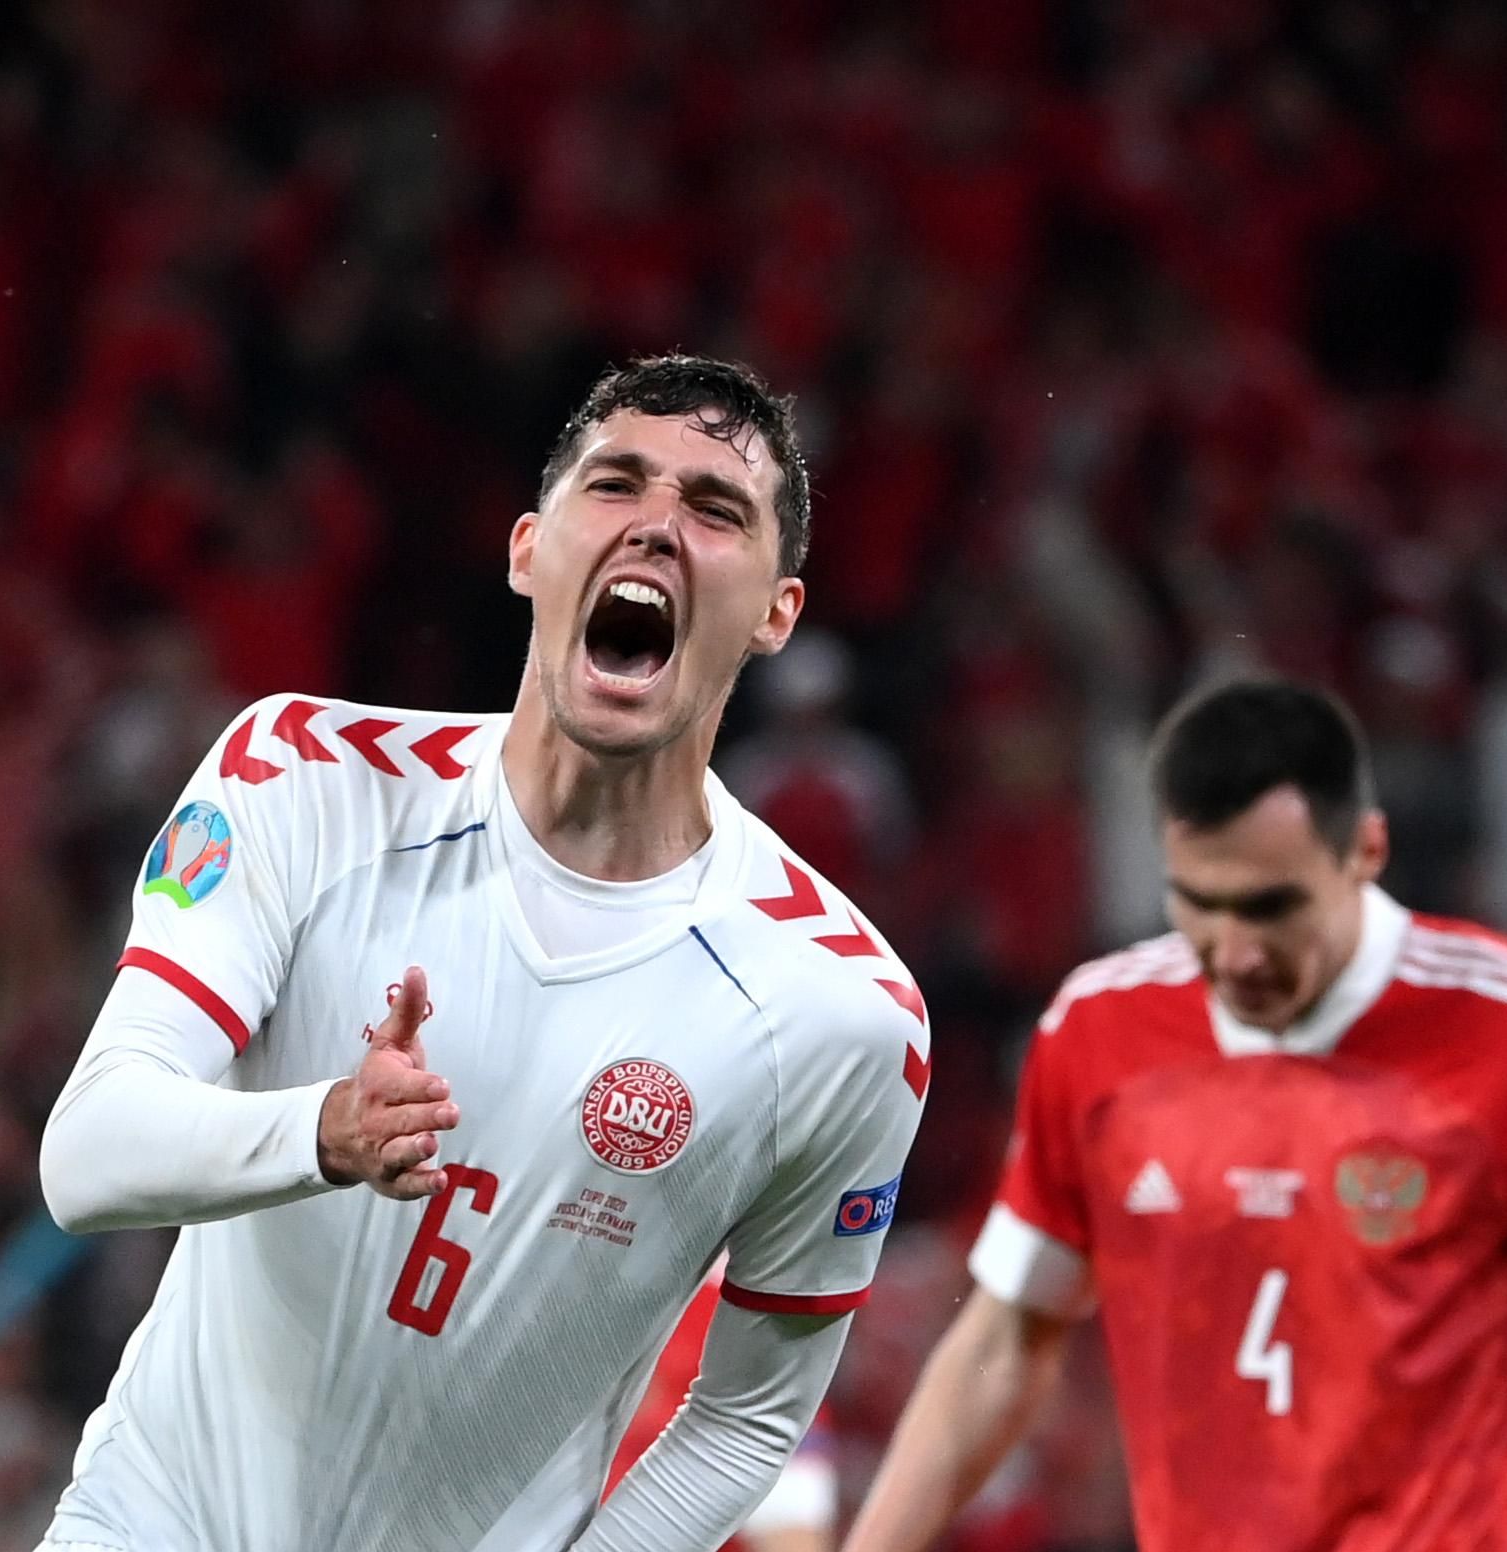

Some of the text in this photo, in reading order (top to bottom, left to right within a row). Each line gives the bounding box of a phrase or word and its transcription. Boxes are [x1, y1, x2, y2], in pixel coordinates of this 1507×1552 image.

[584, 1077, 612, 1145] DANSK
[651, 1109, 691, 1165] UNION
[602, 1090, 673, 1139] DBU
[600, 1147, 645, 1169] 1889
[387, 1162, 499, 1337] 6
[595, 1211, 638, 1233] DENMARK
[1236, 1267, 1294, 1416] 4
